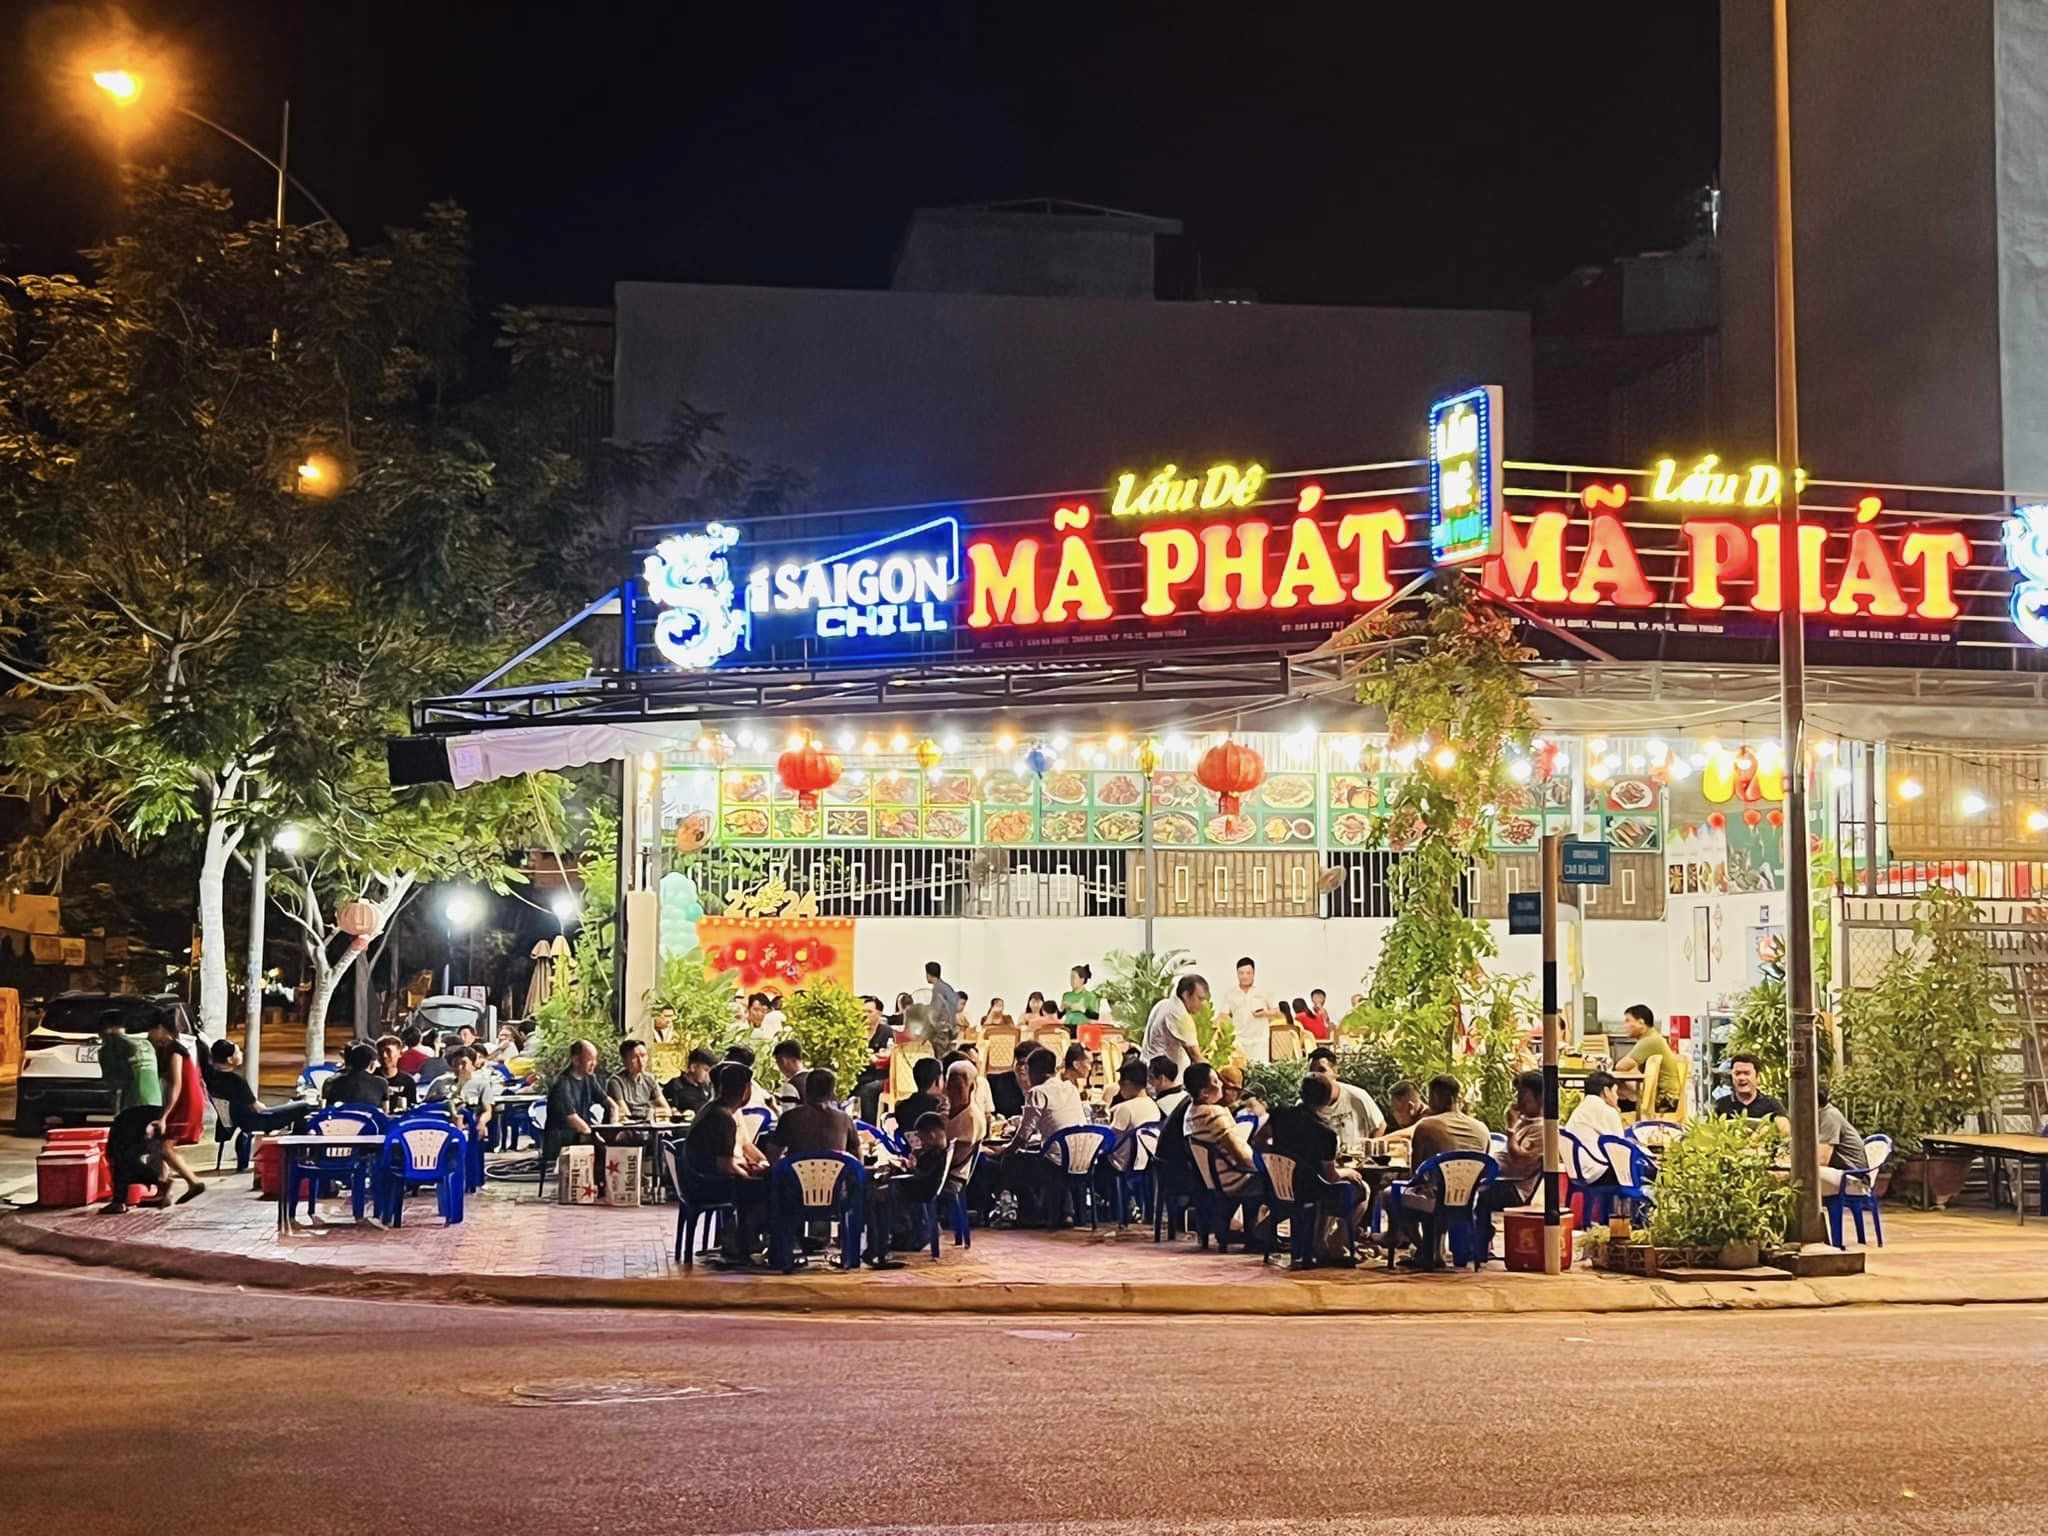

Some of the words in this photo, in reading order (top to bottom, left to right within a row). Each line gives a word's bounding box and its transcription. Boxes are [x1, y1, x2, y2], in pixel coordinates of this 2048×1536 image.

[1744, 465, 1807, 507] D
[967, 504, 1114, 628] MÃ
[1138, 485, 1407, 617] PHÁT
[1482, 484, 1656, 607] MÃ
[774, 557, 948, 610] SAIGON
[817, 602, 948, 637] CHILL
